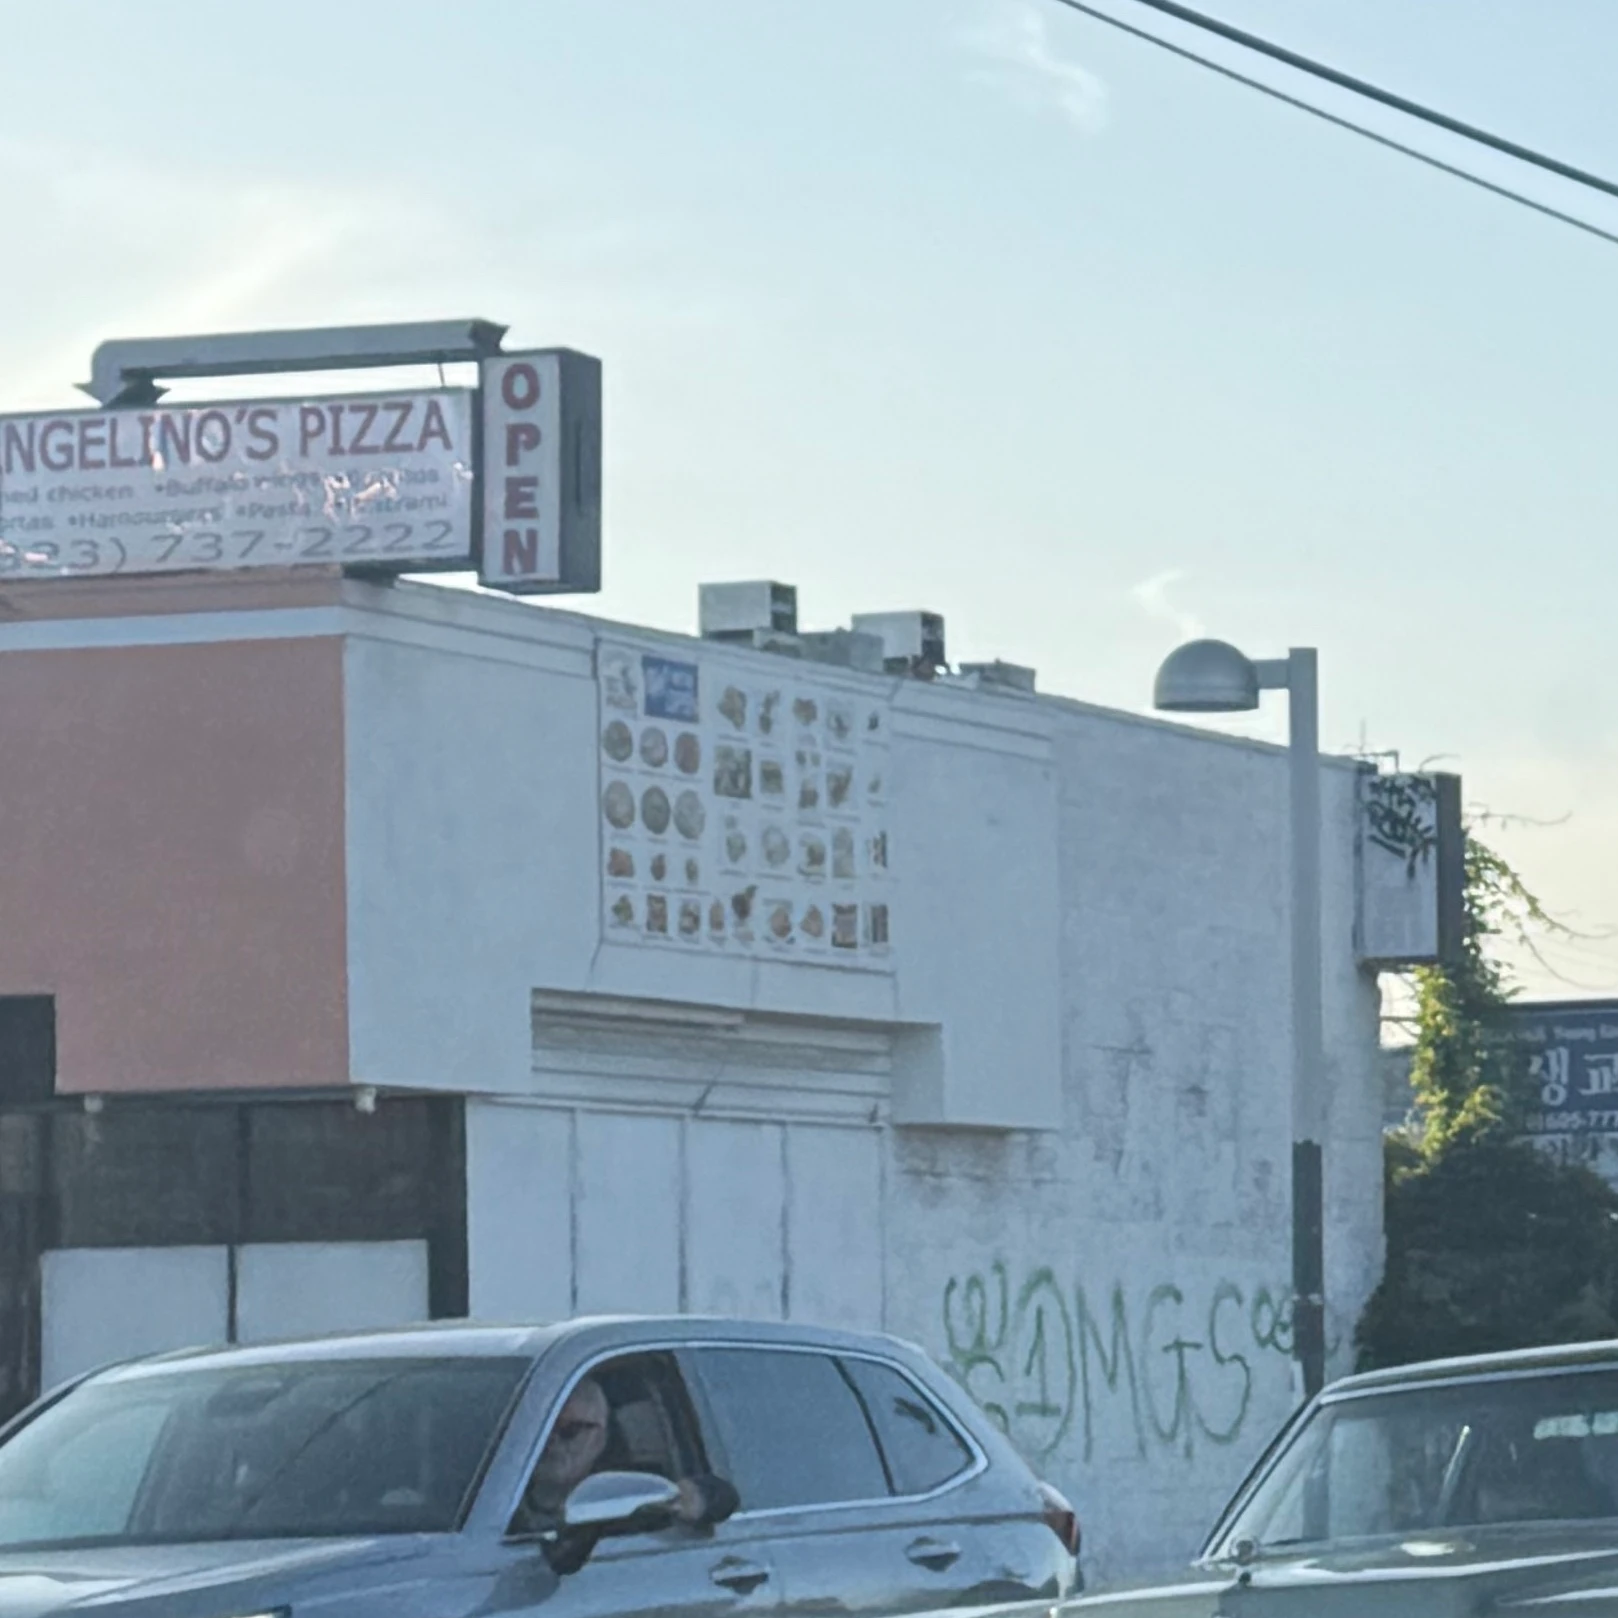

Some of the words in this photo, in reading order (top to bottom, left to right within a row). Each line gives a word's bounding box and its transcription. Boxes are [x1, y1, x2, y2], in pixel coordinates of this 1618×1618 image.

[0, 408, 281, 474] NGELINO'S
[299, 398, 453, 458] PIZZA
[501, 362, 541, 576] OPEN
[151, 518, 458, 564] 737-2222
